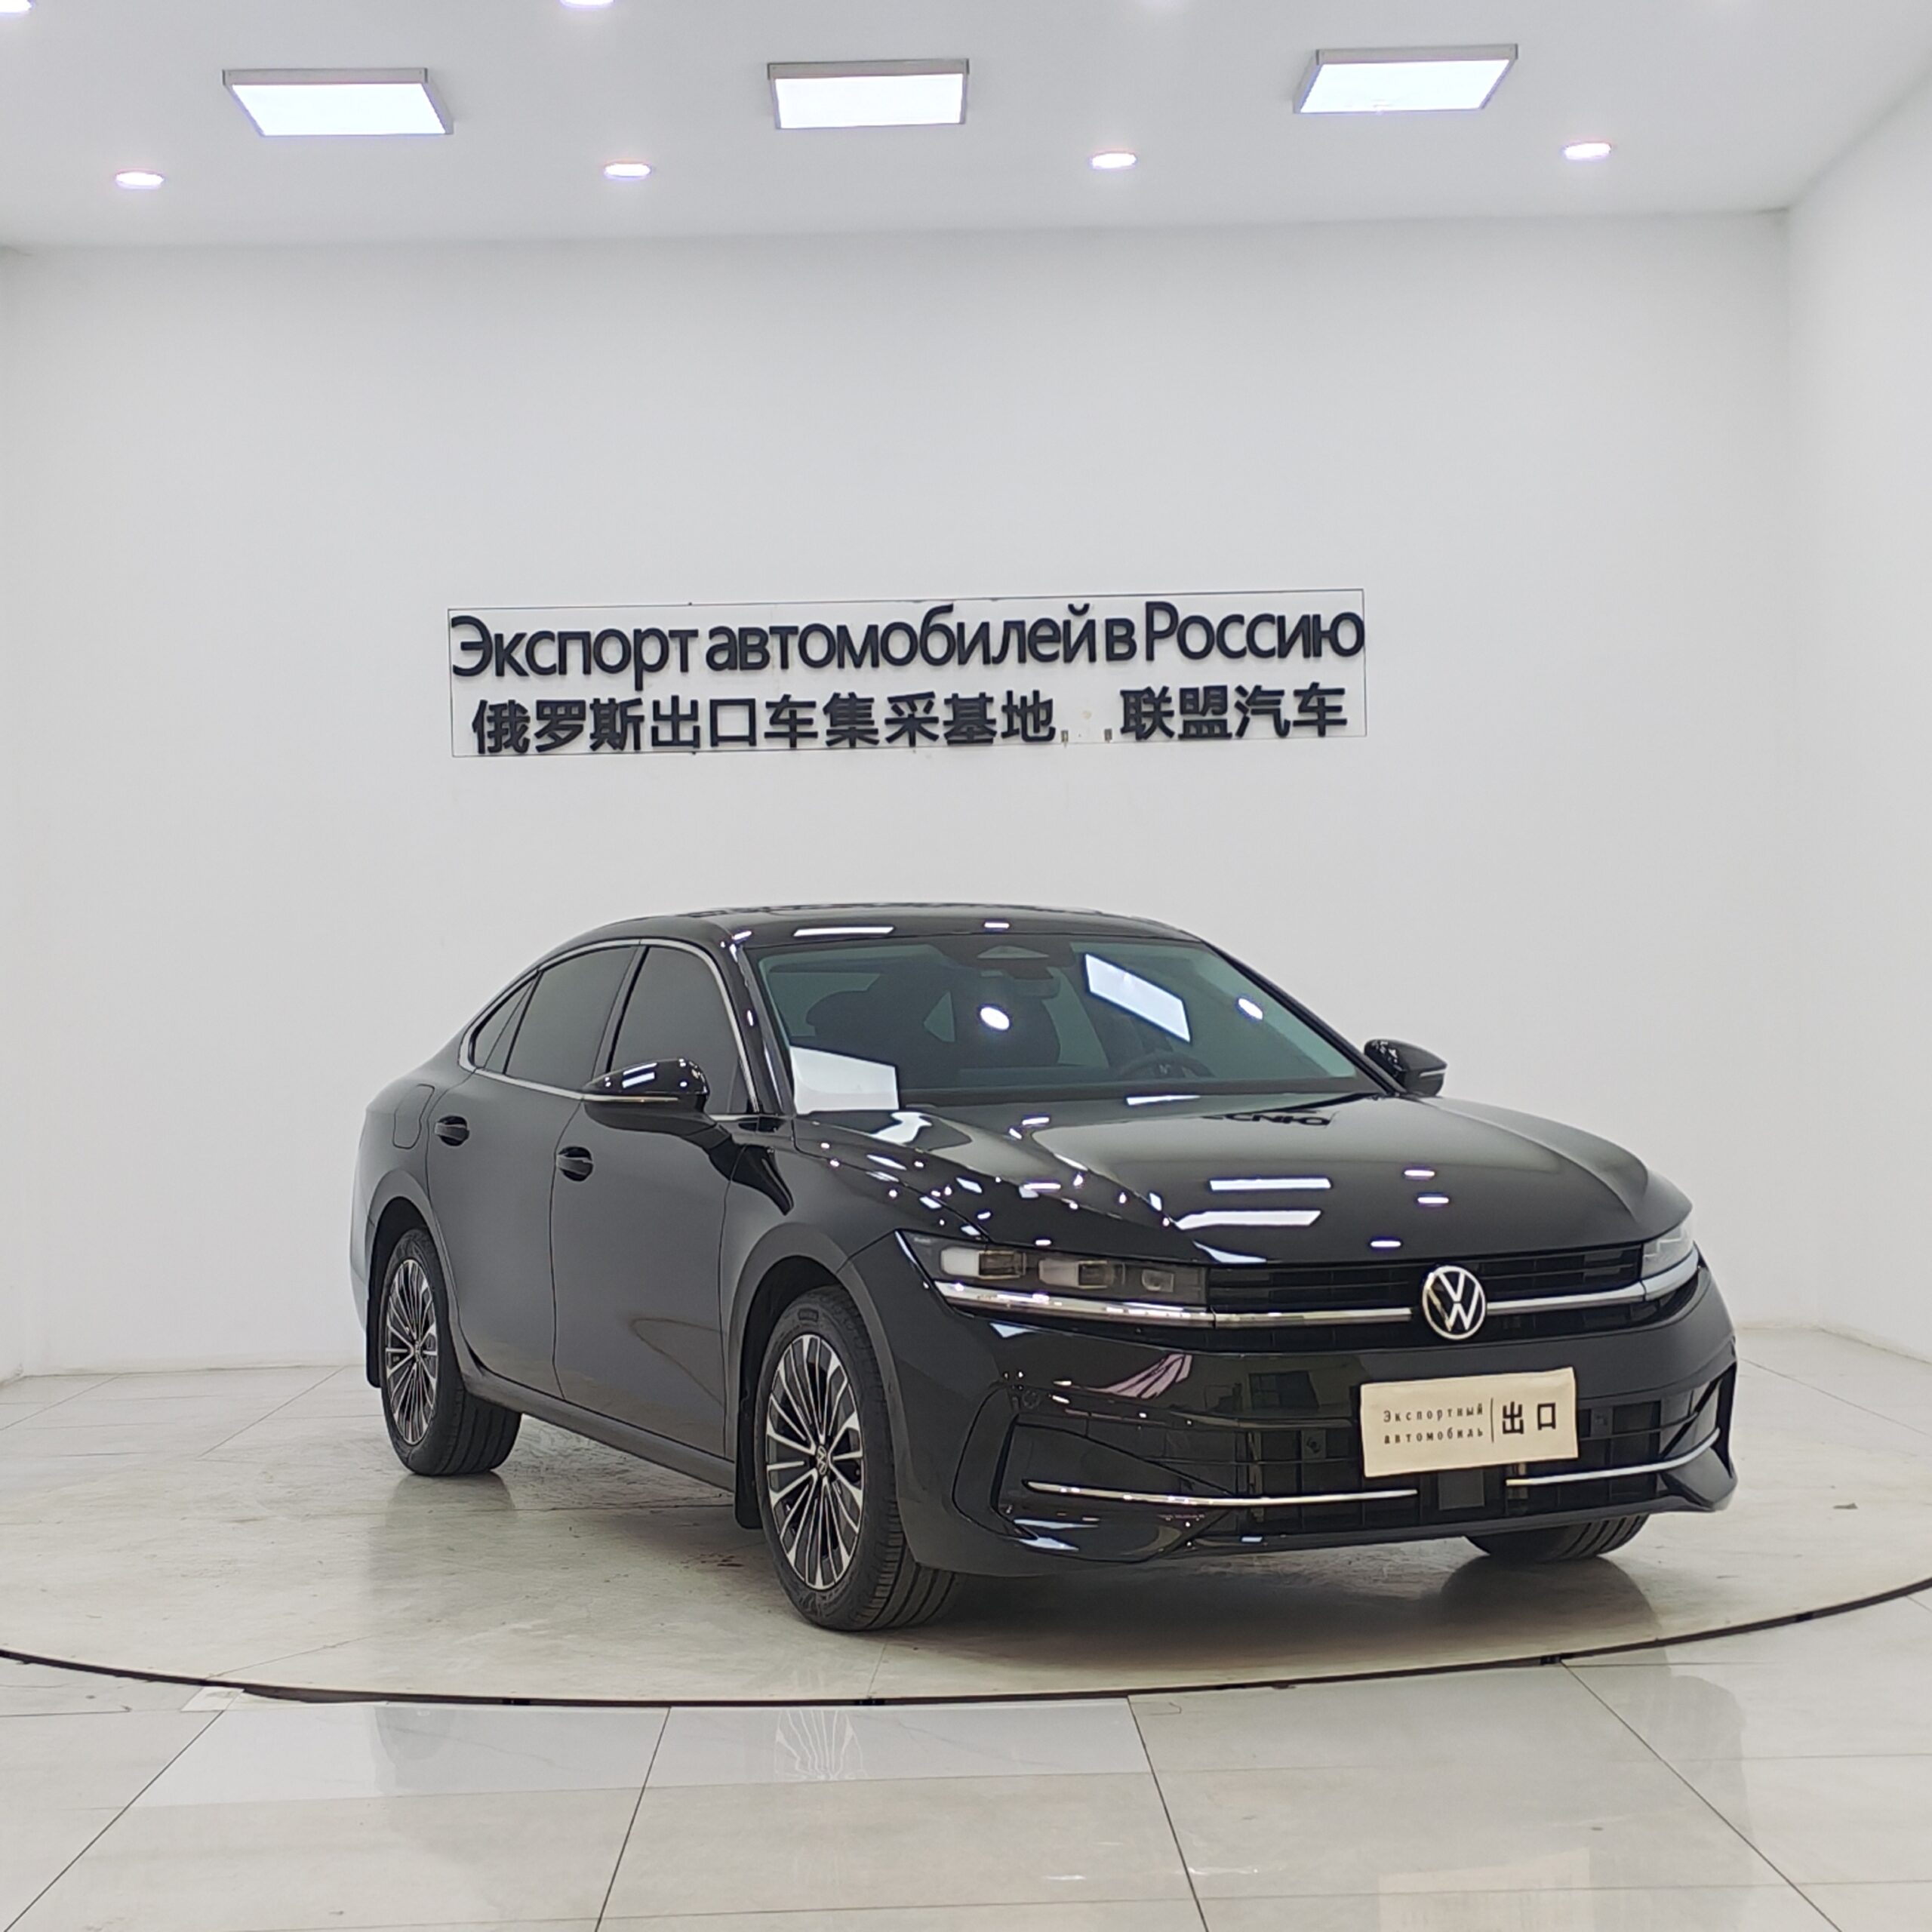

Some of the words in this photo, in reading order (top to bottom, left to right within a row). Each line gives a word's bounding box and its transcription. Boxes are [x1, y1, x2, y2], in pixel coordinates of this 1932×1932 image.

[451, 616, 699, 691] Экспорт
[705, 603, 1097, 670] автомобилей
[1145, 601, 1364, 661] Россию
[471, 690, 1056, 754] 俄罗斯出口车集采基地
[1120, 682, 1347, 740] 联盟汽车
[1424, 1267, 1484, 1336] VW
[1383, 1403, 1483, 1423] Экспортный
[1384, 1427, 1484, 1444] автомобиль
[1502, 1401, 1556, 1435] 出口
